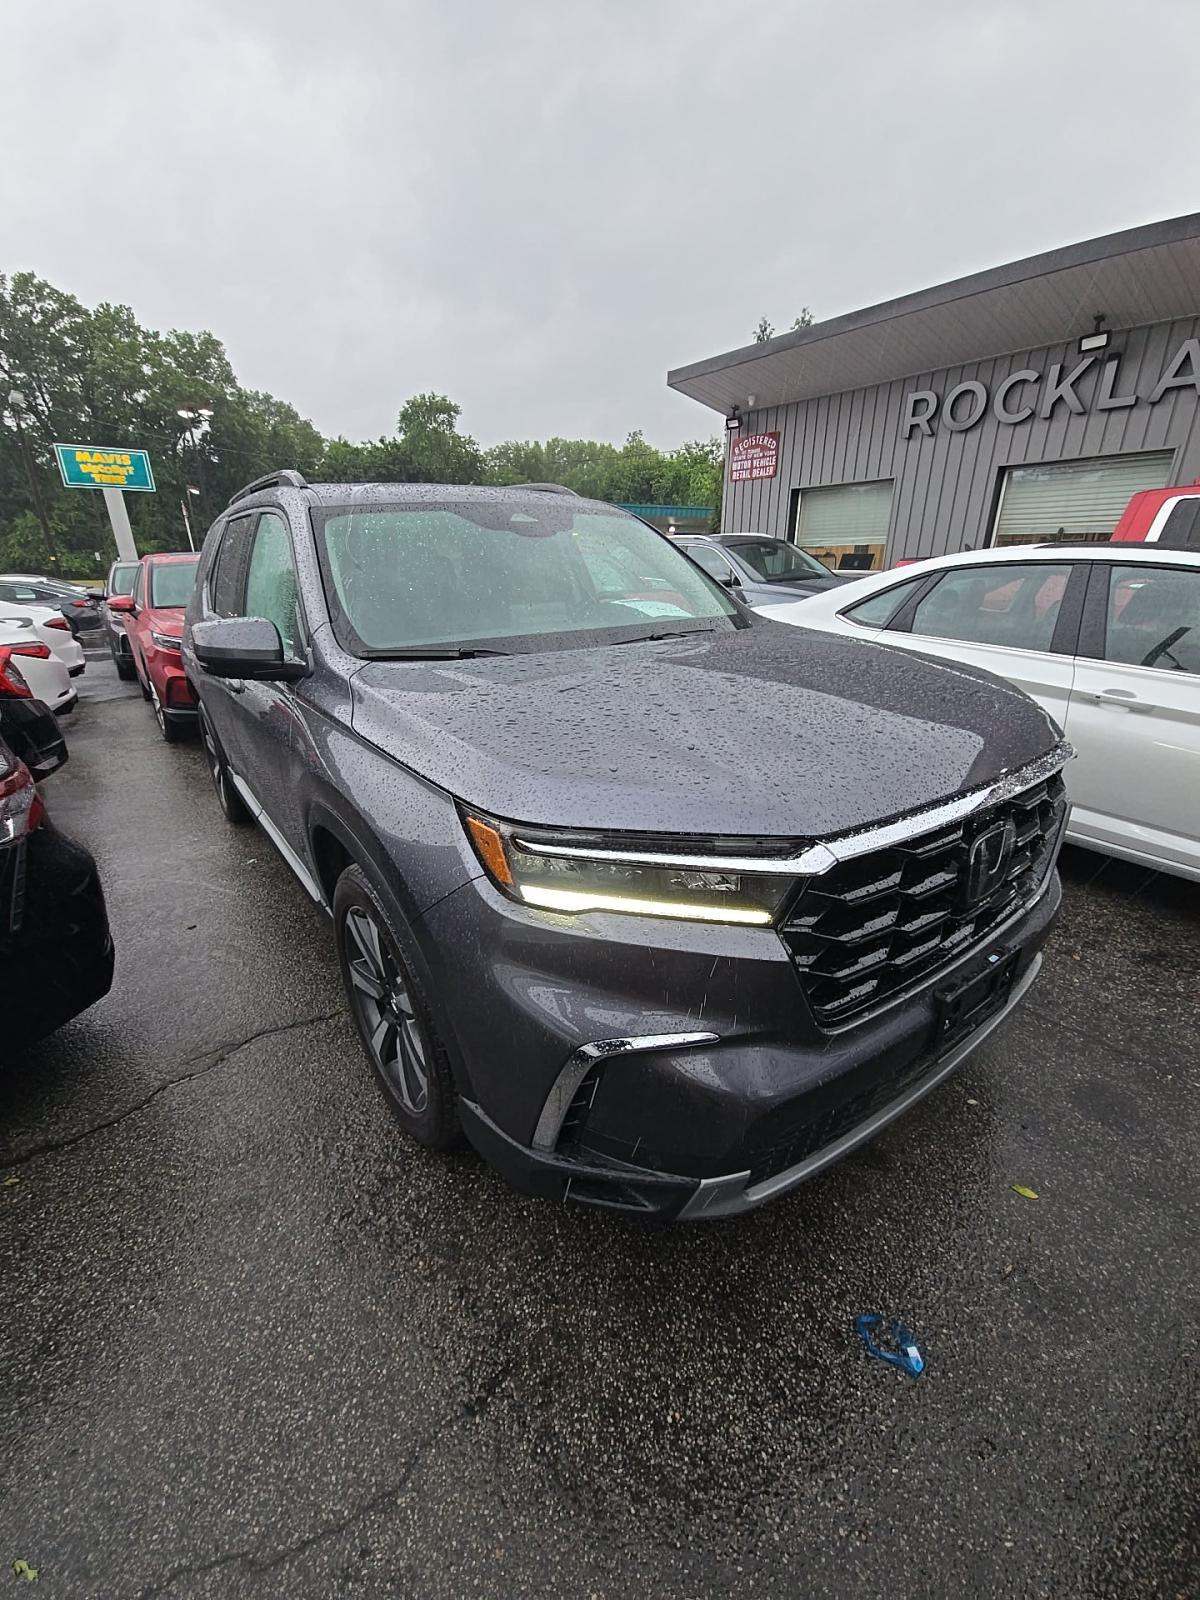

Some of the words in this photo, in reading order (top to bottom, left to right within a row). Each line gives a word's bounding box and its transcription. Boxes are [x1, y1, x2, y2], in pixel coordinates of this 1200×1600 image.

[734, 435, 777, 455] REGISTERED
[76, 450, 130, 465] MAVIS
[732, 460, 752, 471] MOTOR
[752, 456, 777, 468] VEHICLE
[732, 470, 750, 480] RETAIL
[752, 466, 774, 478] DEALER
